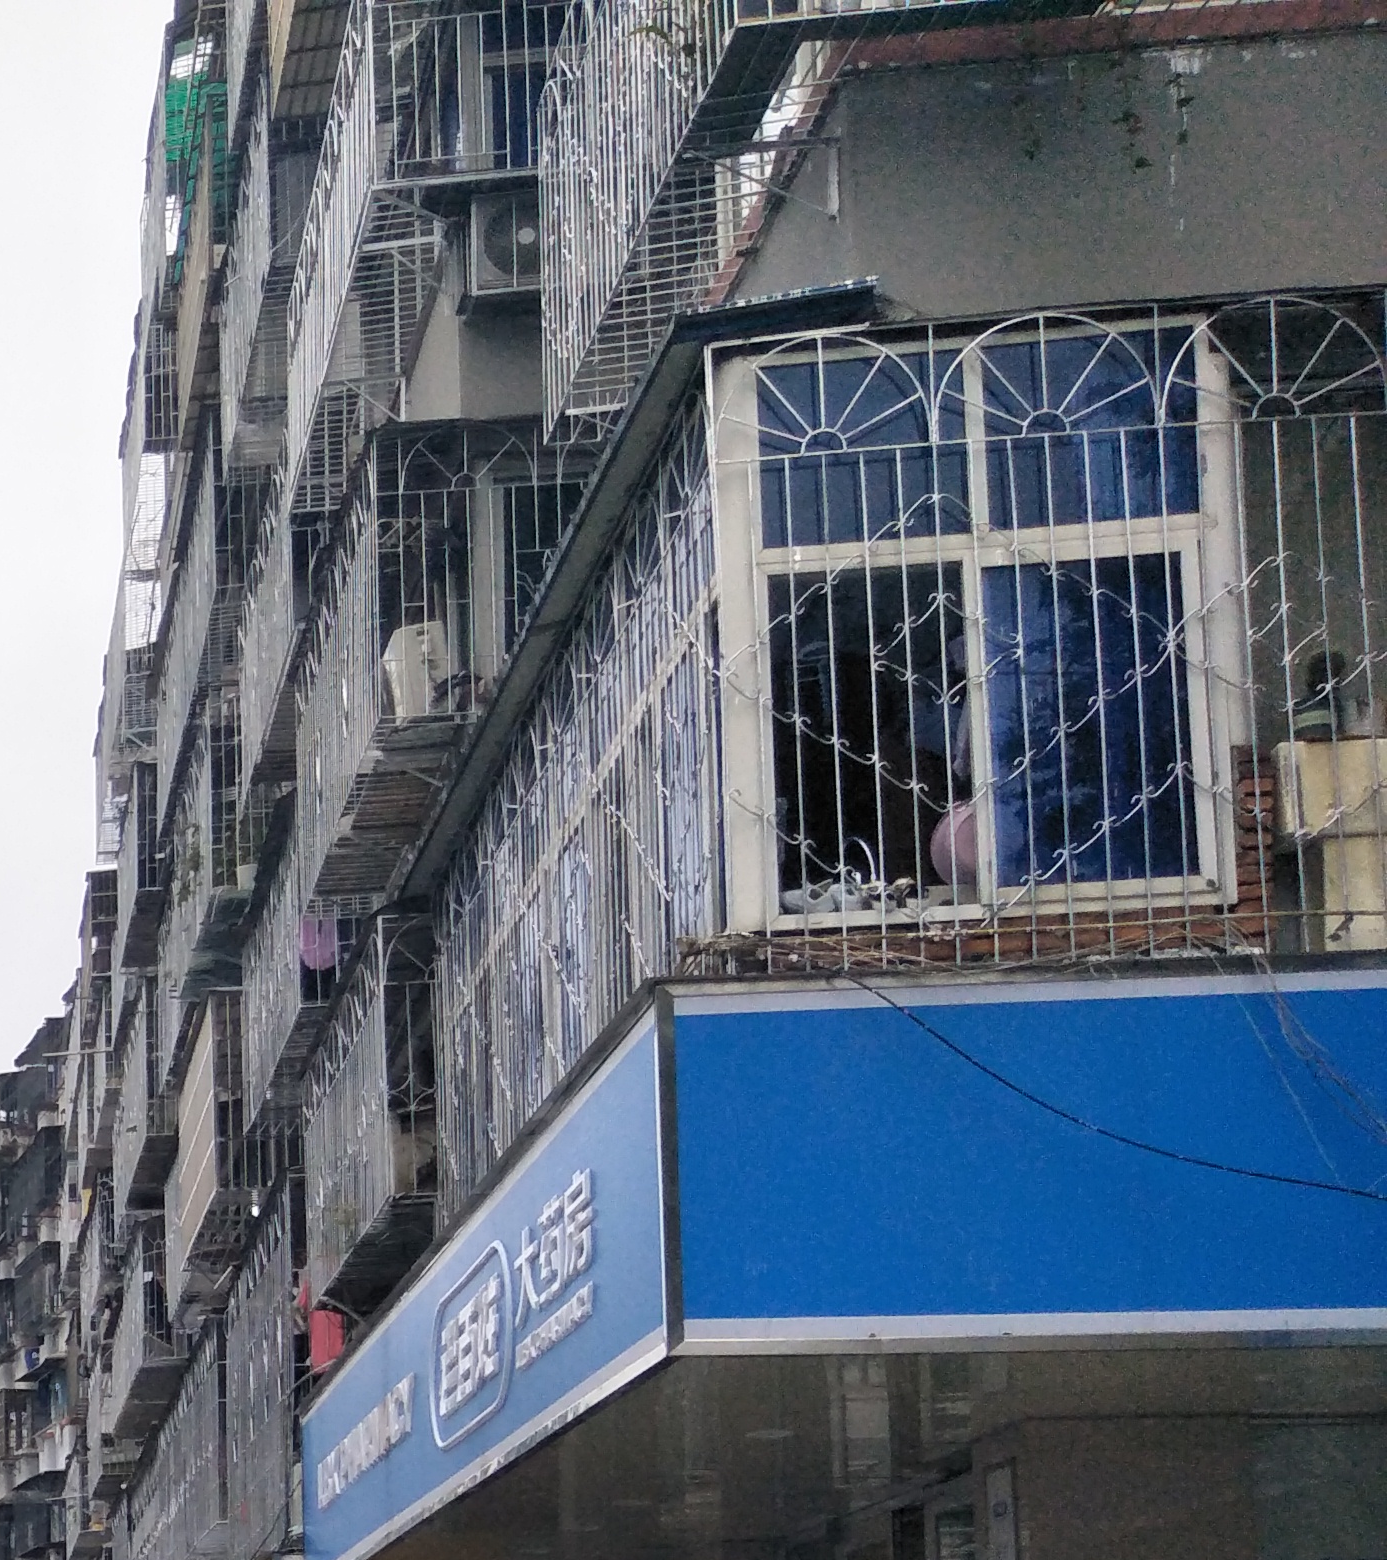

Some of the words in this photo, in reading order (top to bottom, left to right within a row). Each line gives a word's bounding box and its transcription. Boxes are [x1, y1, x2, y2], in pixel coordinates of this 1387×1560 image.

[439, 1272, 501, 1420] 老百姓
[514, 1168, 593, 1331] 大药房
